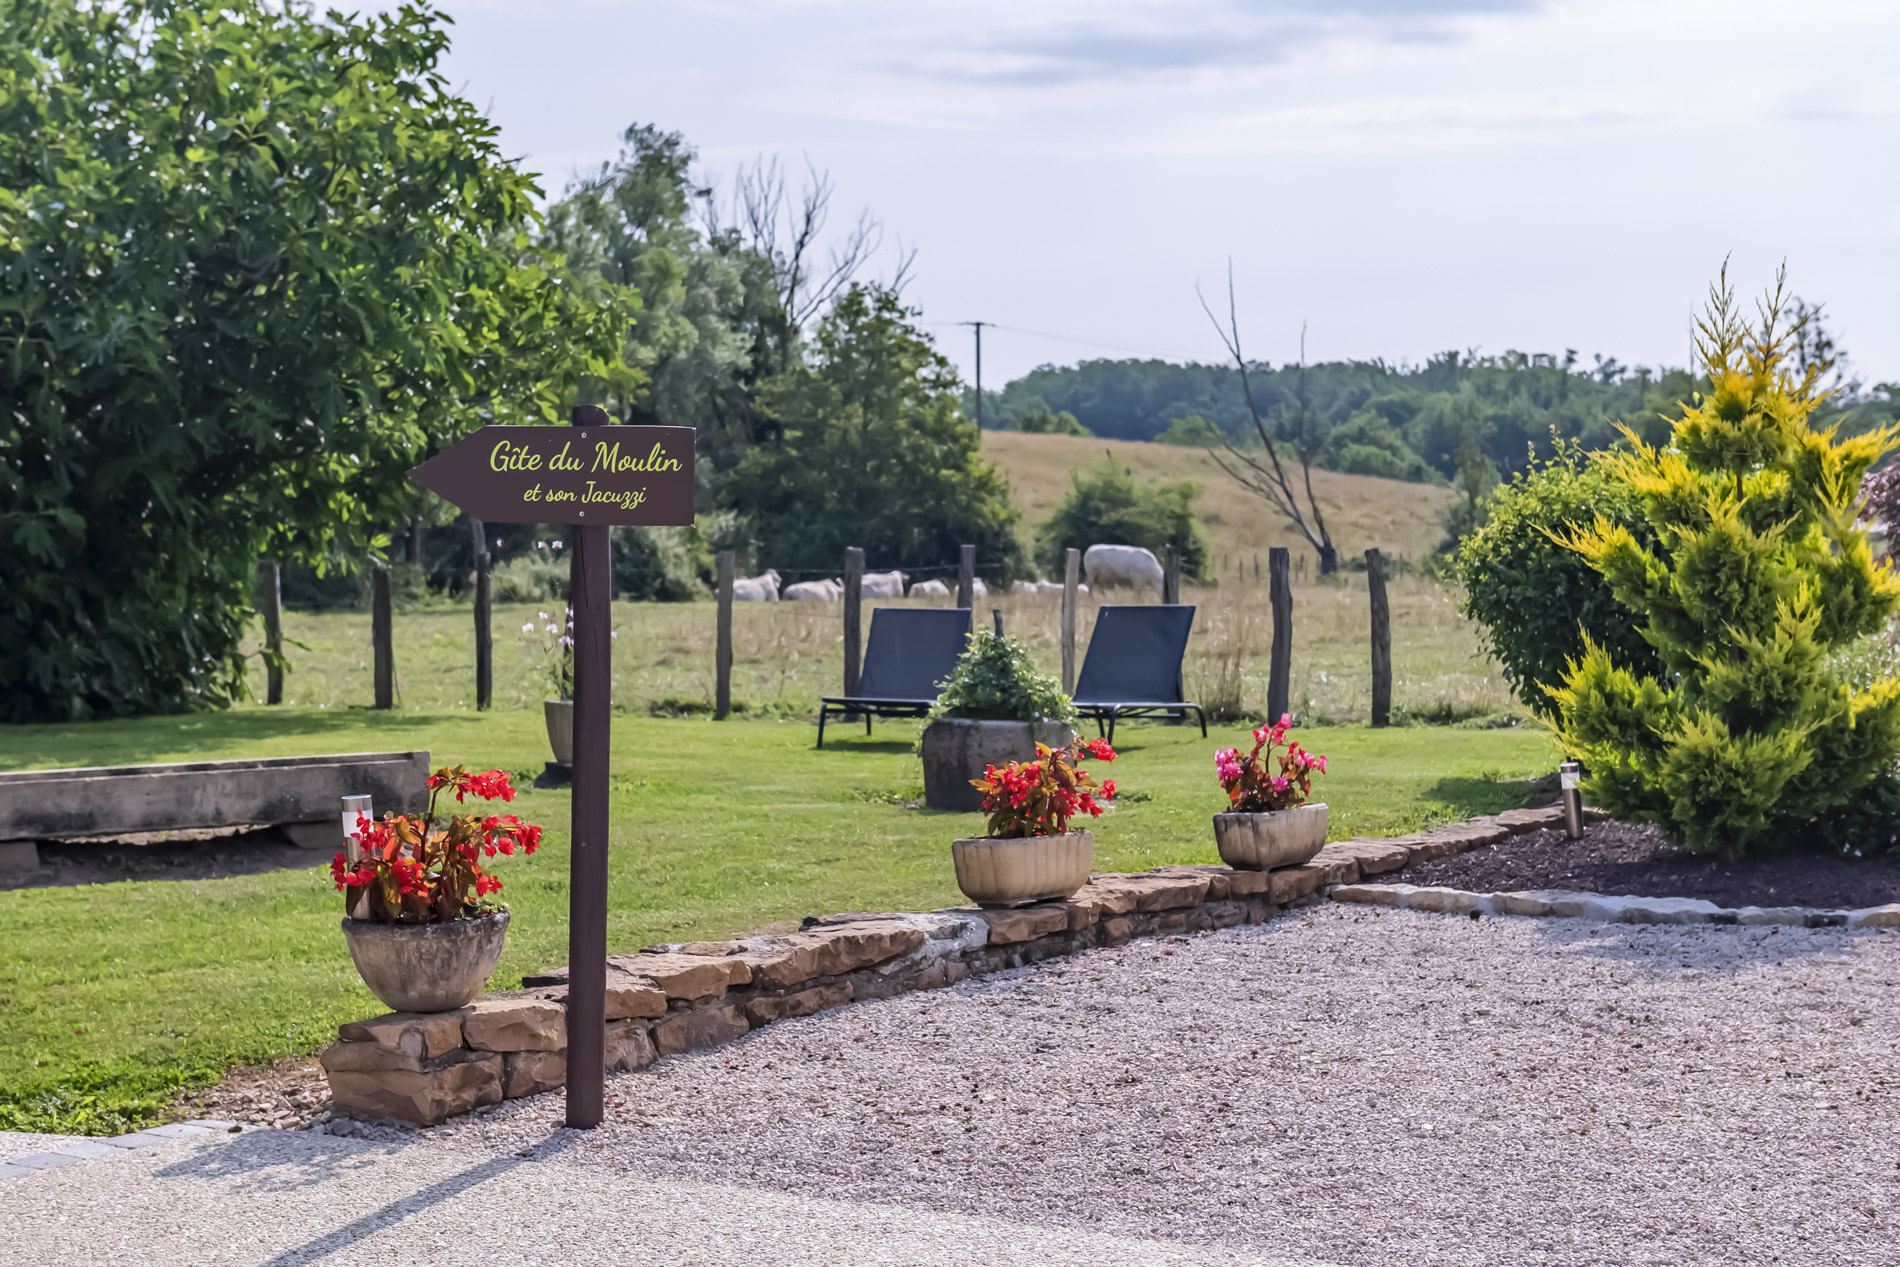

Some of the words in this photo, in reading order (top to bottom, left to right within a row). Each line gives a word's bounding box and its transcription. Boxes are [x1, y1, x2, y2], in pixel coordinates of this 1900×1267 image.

[489, 440, 543, 473] Gîte
[548, 441, 585, 472] du
[590, 441, 683, 474] Moulin
[523, 483, 543, 503] et
[545, 489, 578, 503] son
[581, 481, 647, 510] Jacuzzi
